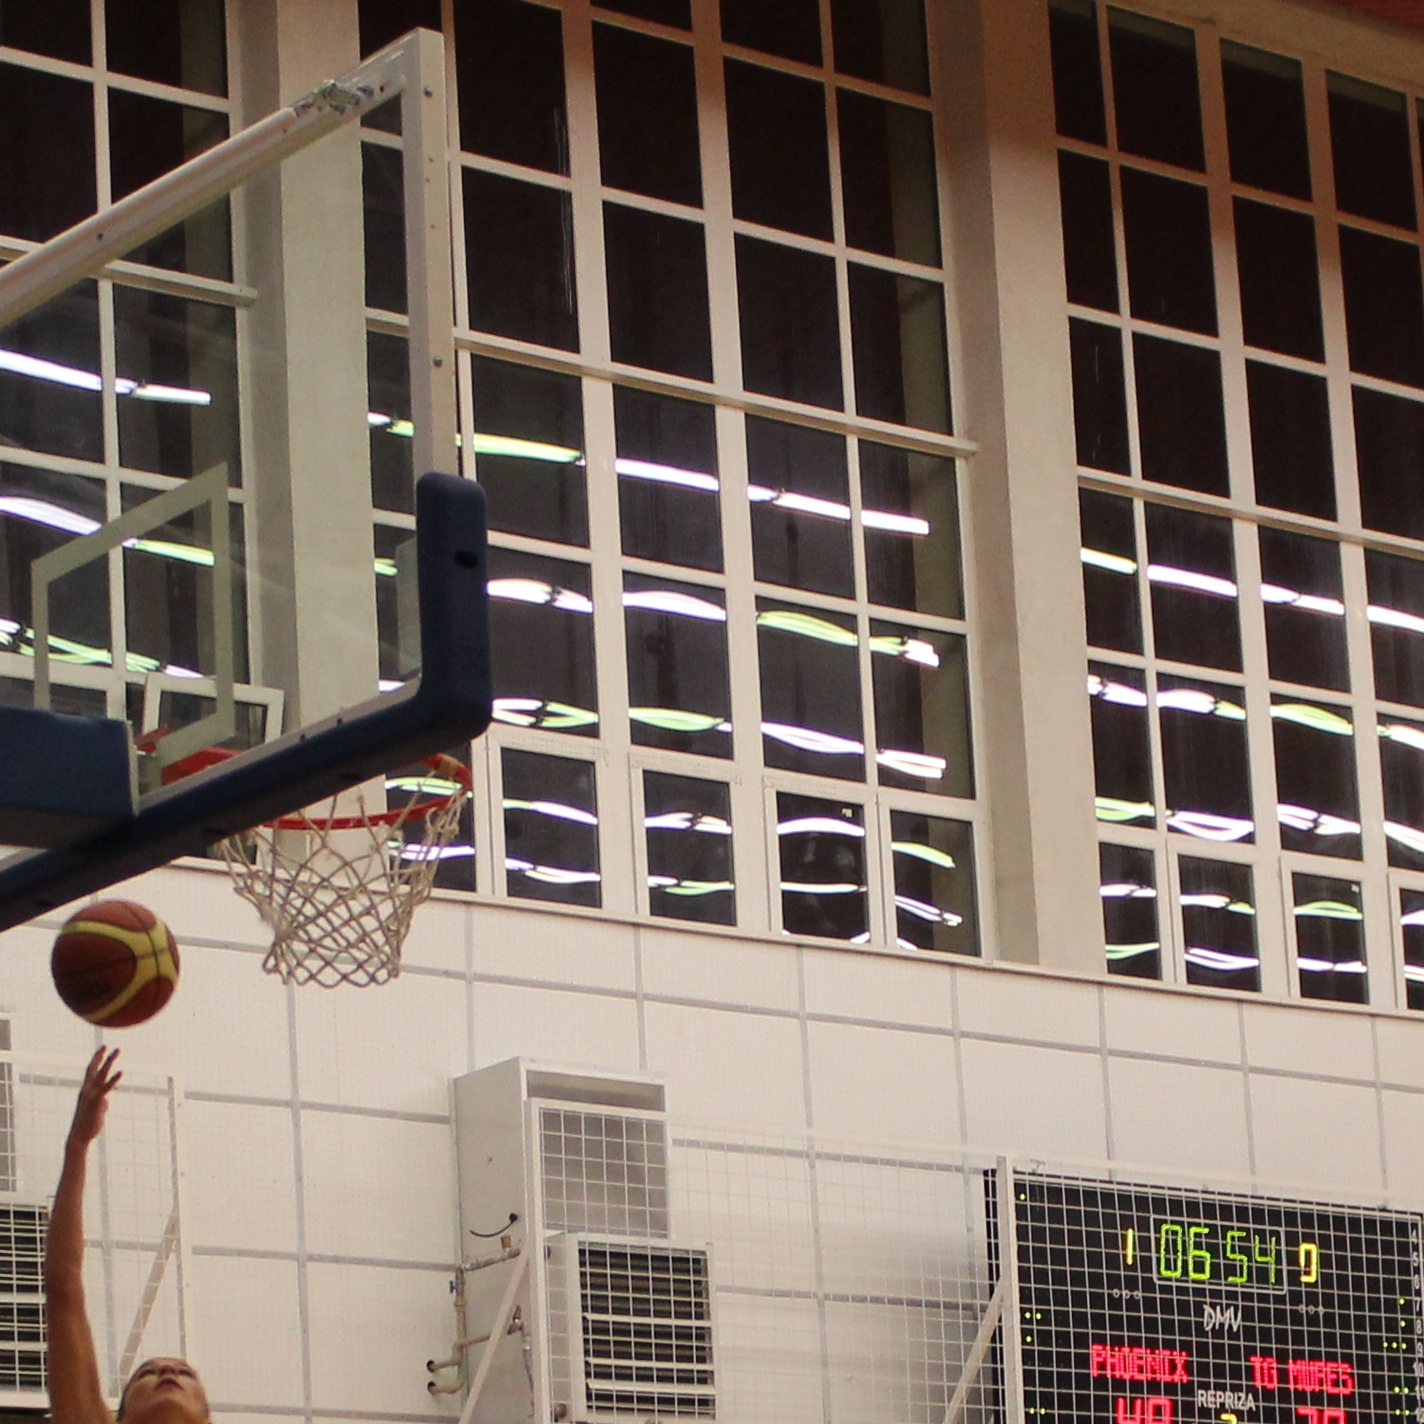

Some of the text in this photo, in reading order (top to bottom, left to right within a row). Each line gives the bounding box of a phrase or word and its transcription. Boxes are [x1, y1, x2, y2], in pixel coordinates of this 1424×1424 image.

[1091, 1344, 1190, 1384] PHOENIX
[1250, 1356, 1278, 1389] TG
[1198, 1390, 1256, 1412] REPRIZA
